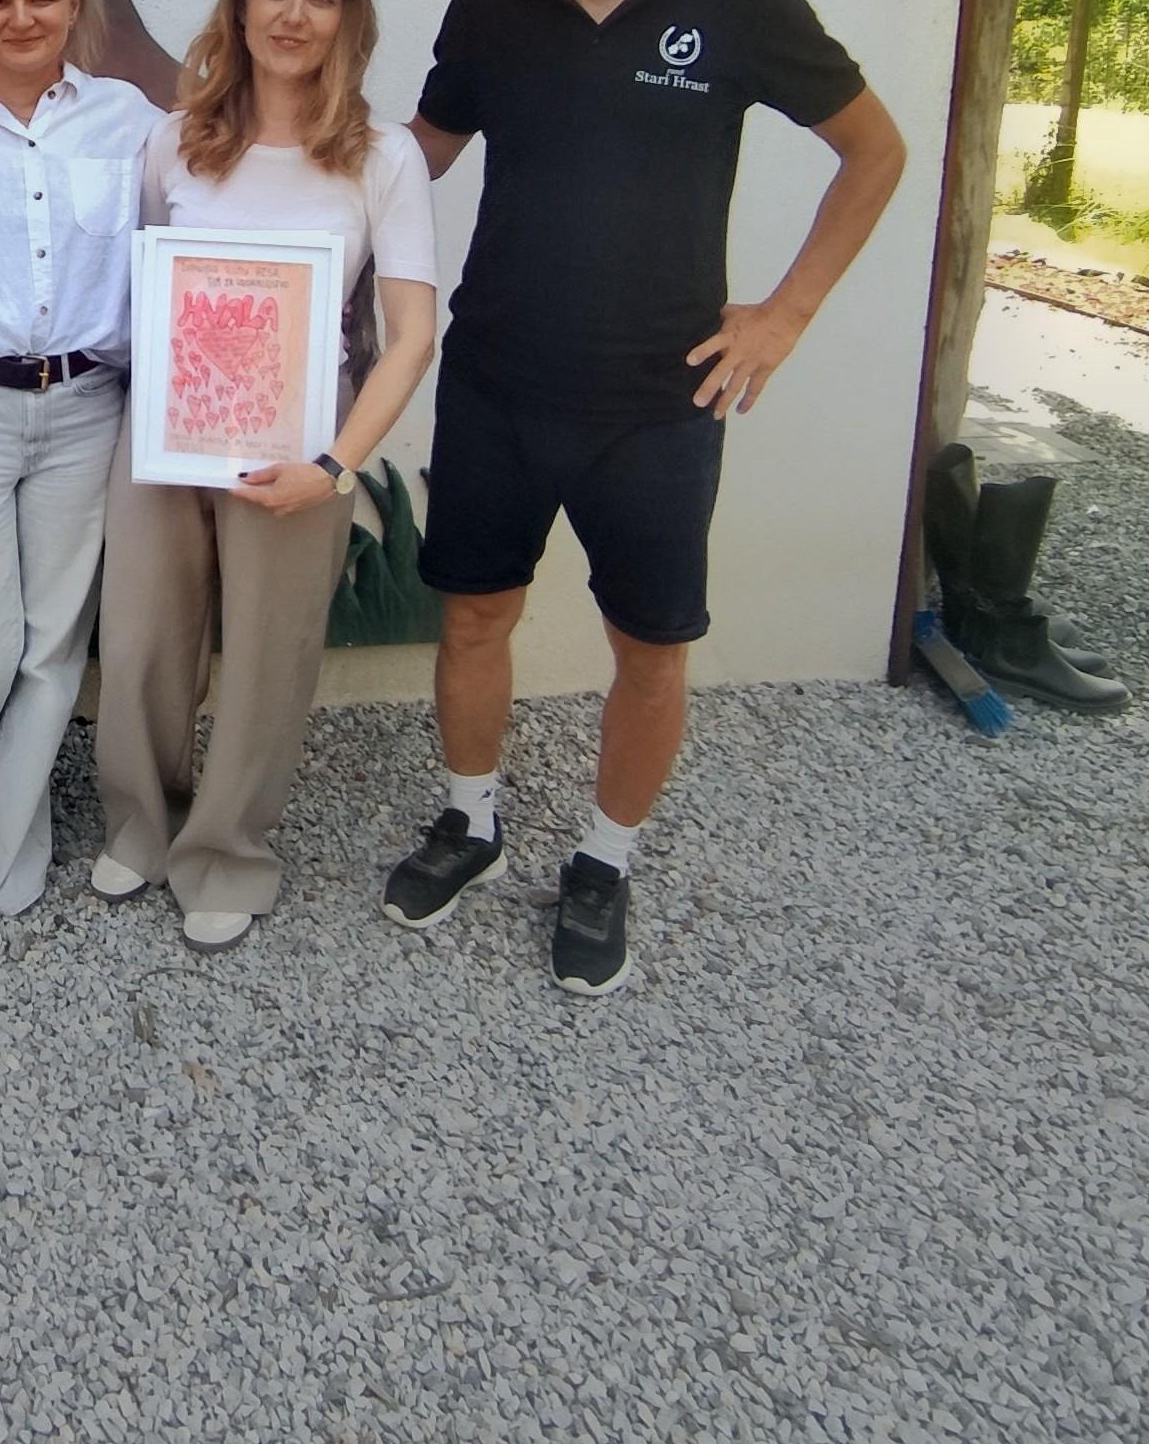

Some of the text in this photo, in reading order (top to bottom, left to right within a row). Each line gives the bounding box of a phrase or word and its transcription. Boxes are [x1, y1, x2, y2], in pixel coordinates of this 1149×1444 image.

[634, 69, 670, 86] Stari
[672, 75, 710, 93] Hrast
[177, 290, 278, 332] HVALA
